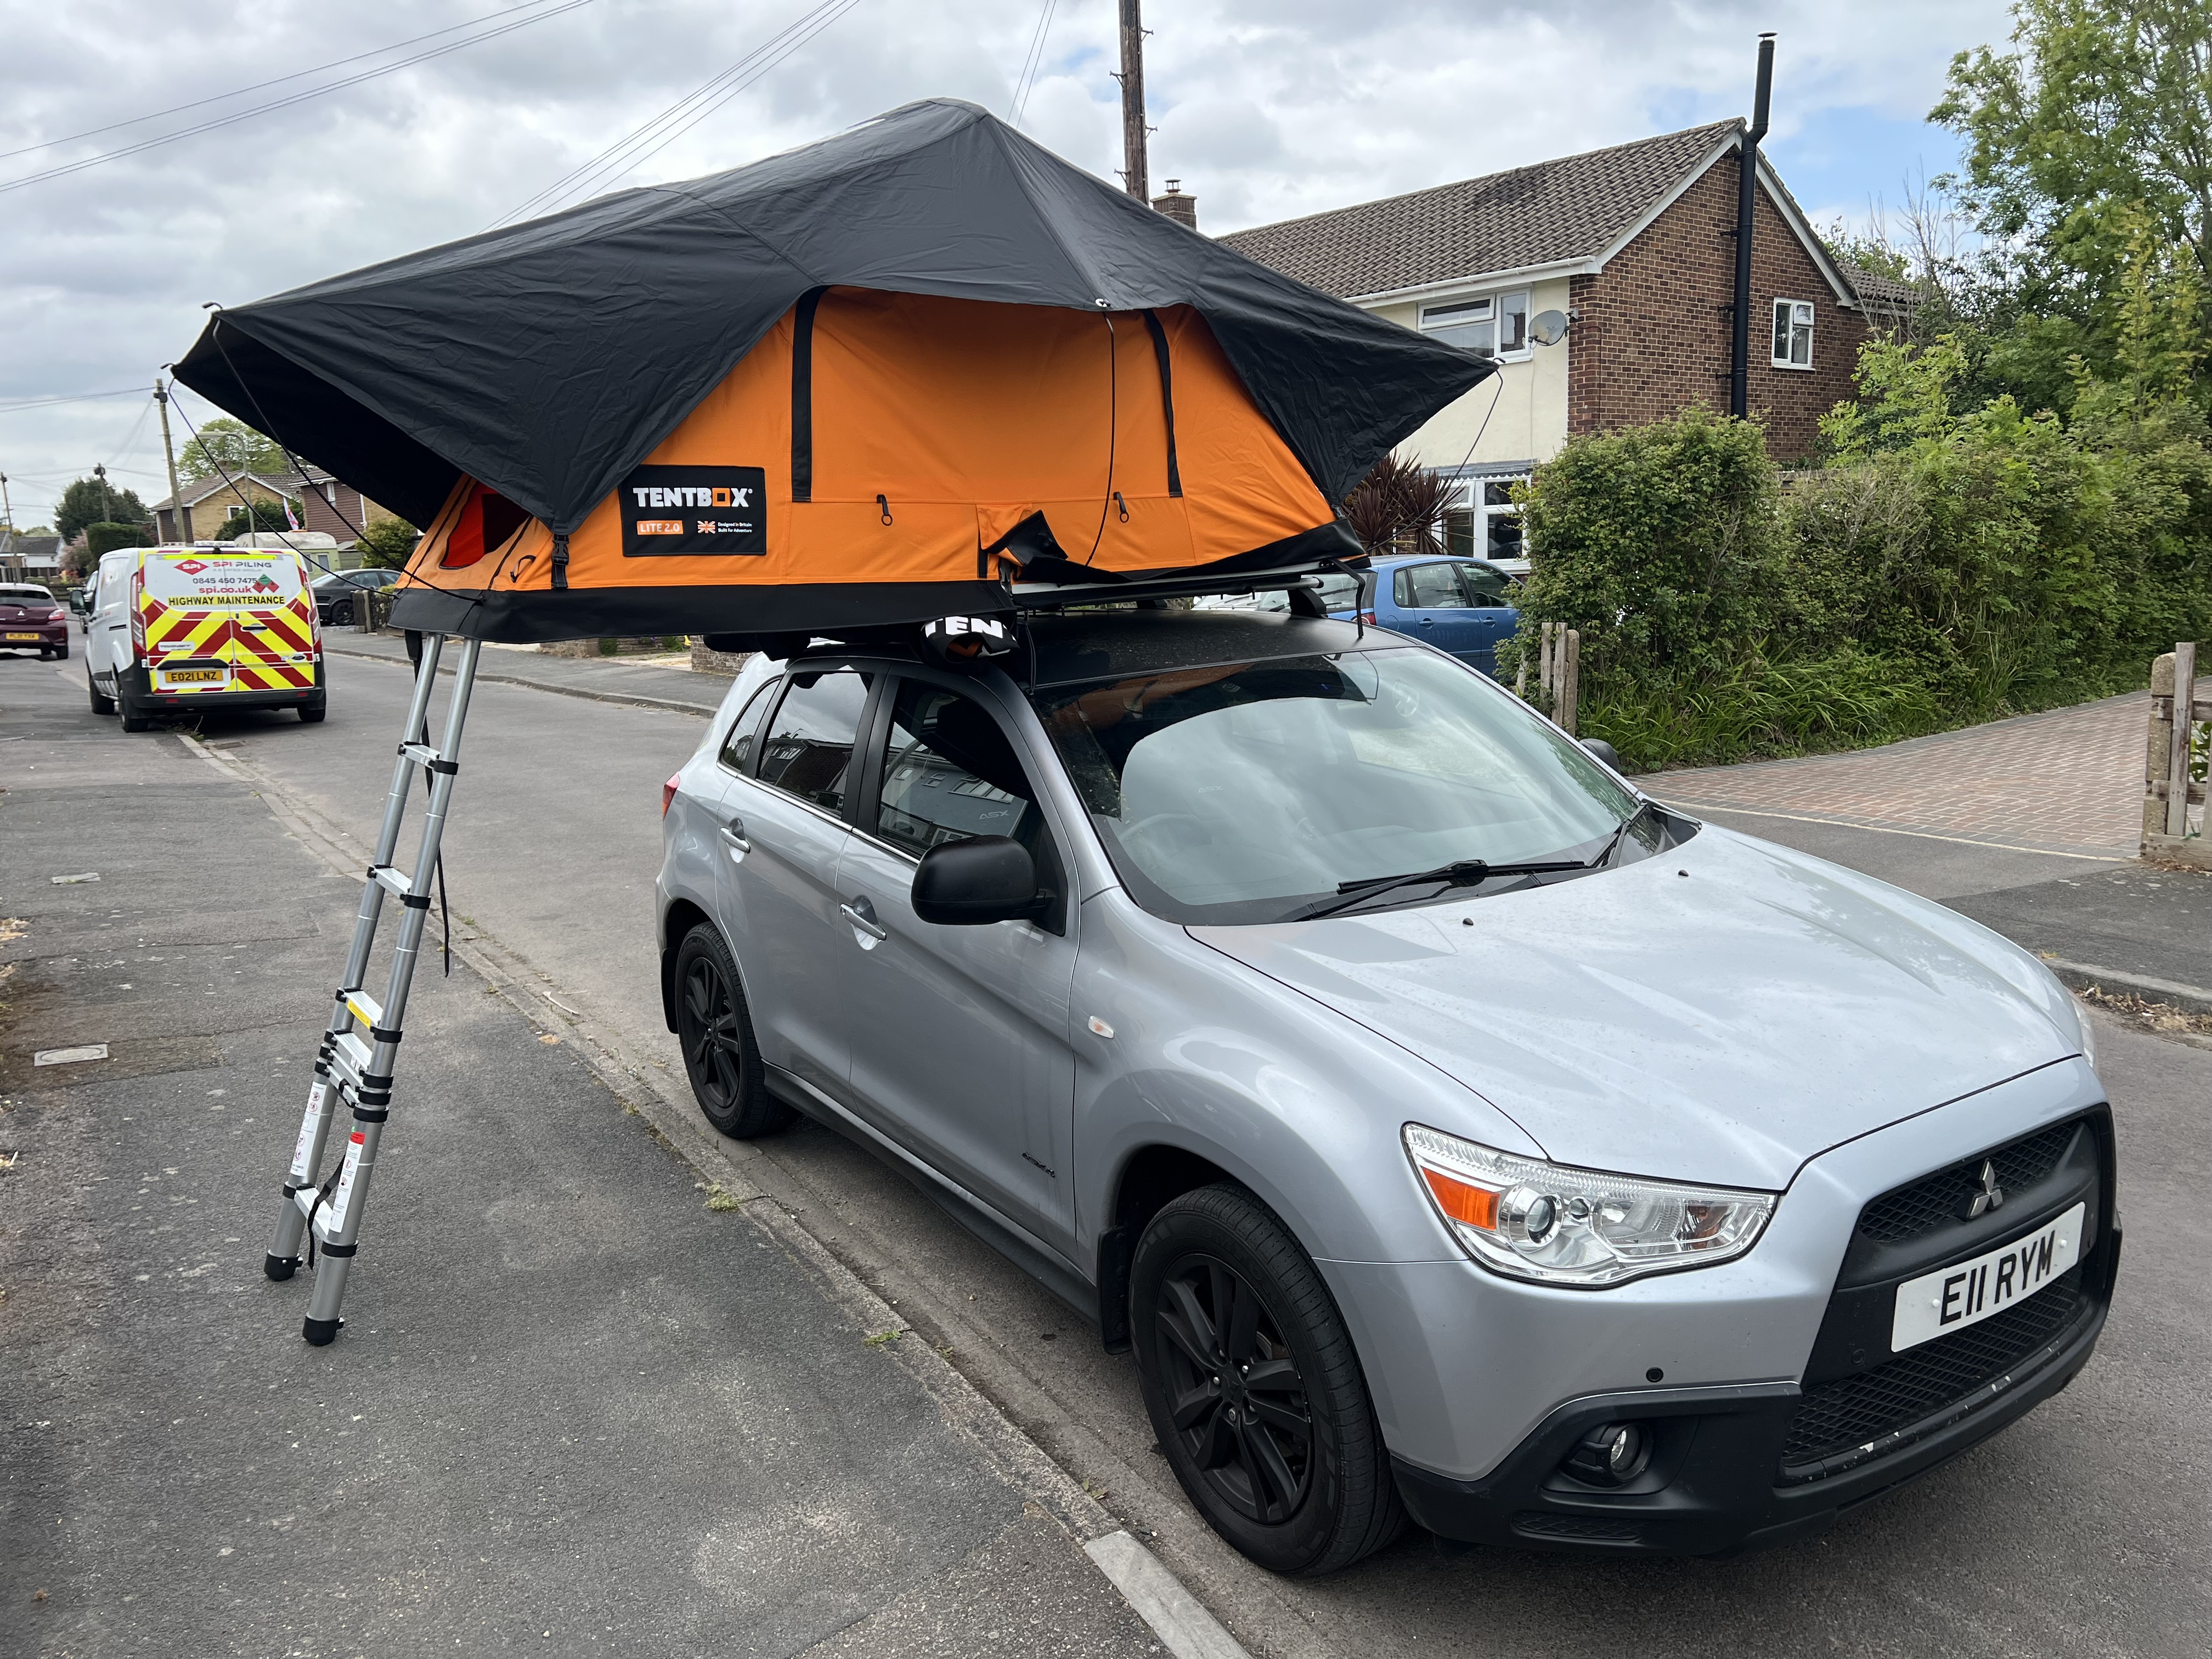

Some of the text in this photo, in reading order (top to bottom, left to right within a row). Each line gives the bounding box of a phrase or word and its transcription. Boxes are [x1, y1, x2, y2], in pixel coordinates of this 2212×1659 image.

[633, 487, 749, 507] TENTBOX
[640, 522, 680, 533] LITE 2.0
[198, 586, 252, 595] spi.co.uk
[168, 596, 285, 606] HIGHWAY MAINTENANCE
[197, 672, 217, 680] LNZ
[1198, 785, 1223, 793] ASX
[978, 810, 1010, 820] ASX
[1994, 1229, 2056, 1305] RYM
